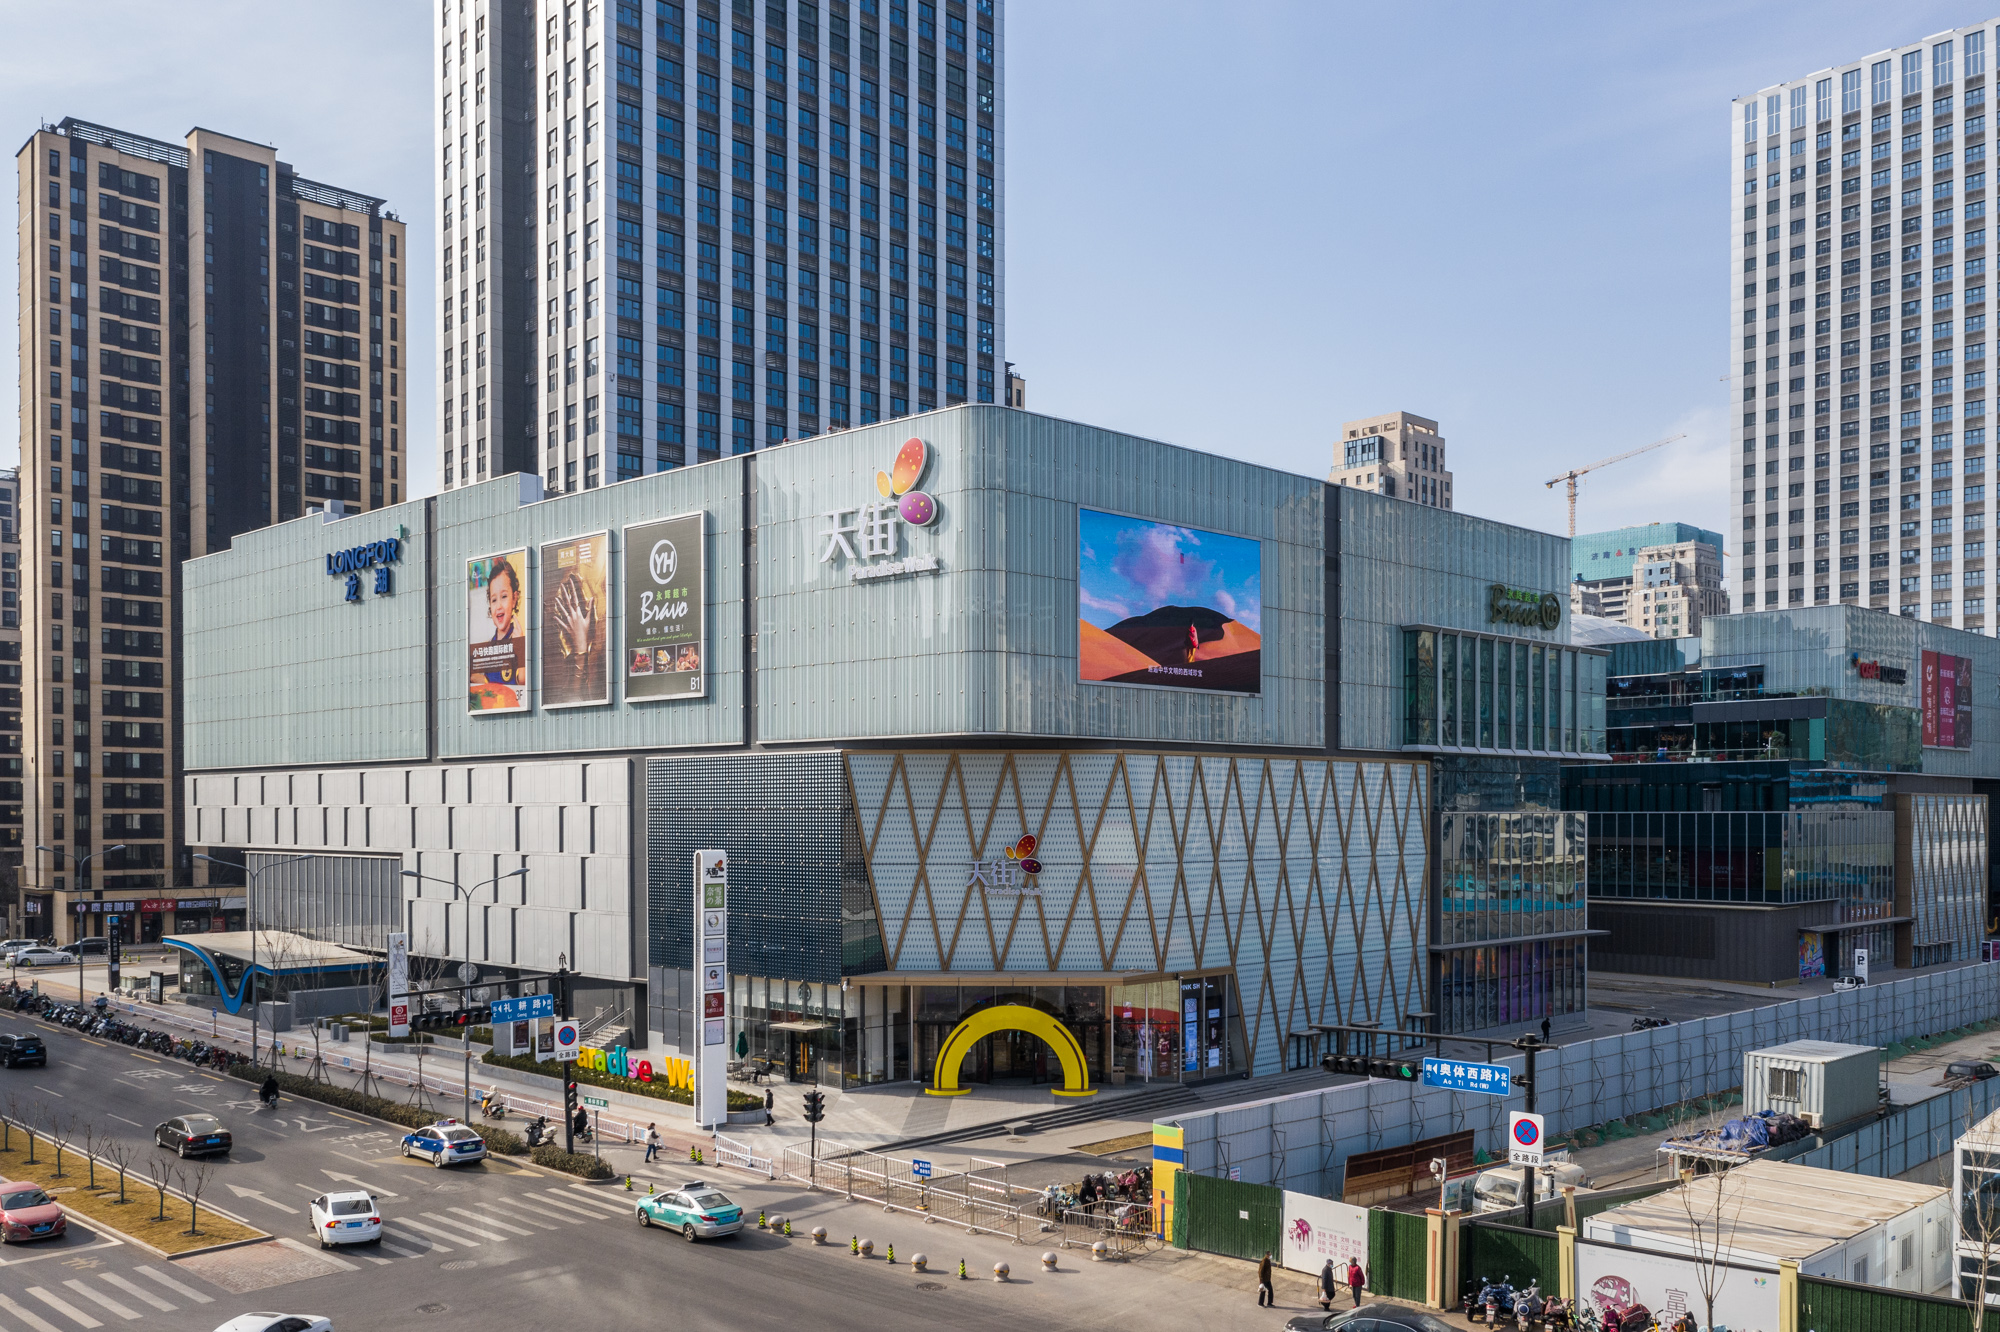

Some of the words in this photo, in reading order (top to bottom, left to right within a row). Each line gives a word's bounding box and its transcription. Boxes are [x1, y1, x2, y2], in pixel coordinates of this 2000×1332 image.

[818, 502, 898, 563] 天街
[326, 537, 398, 576] LONGFOR
[848, 560, 904, 580] Paradise
[903, 553, 939, 573] Walk
[345, 567, 390, 602] 龙湖
[640, 591, 689, 625] Bravo
[472, 643, 514, 658] 小马快跑国际教育
[690, 677, 701, 690] B1
[965, 860, 1018, 887] 天街
[984, 886, 1020, 896] Paradise
[1021, 887, 1043, 896] Walk
[1857, 955, 1865, 966] P
[503, 999, 541, 1013] 礼耕路
[558, 1050, 578, 1059] 全路段
[577, 1044, 653, 1083] aradise
[1425, 1064, 1432, 1072] 南
[1440, 1063, 1492, 1082] 奥体西路
[1500, 1072, 1508, 1081] 北
[1512, 1152, 1539, 1164] 全路段
